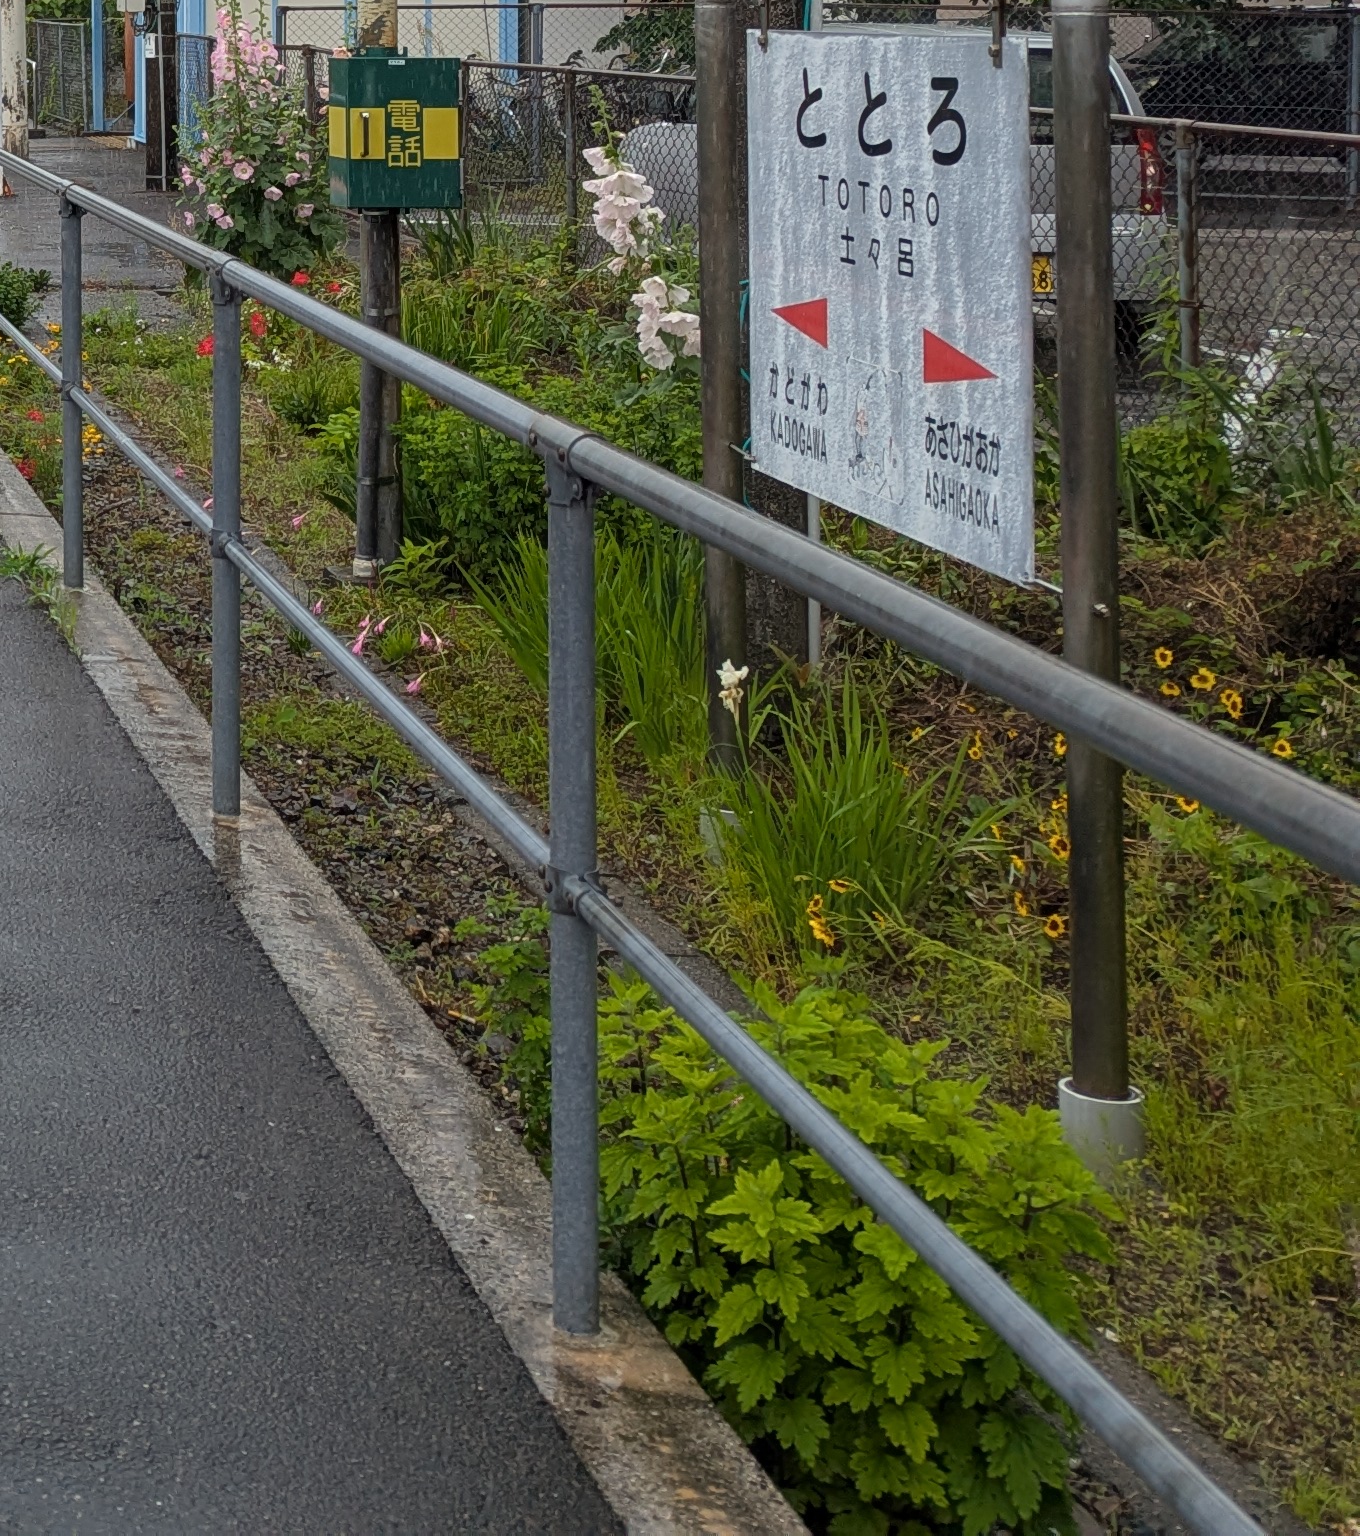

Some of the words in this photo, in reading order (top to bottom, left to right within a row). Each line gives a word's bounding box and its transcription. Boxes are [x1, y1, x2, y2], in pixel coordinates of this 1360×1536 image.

[387, 99, 421, 167] 電話
[796, 67, 967, 166] ととろ
[817, 174, 940, 228] TOTORO
[840, 227, 914, 278] 土々呂
[769, 361, 829, 416] かどがわ
[770, 409, 828, 464] KADOGAWA
[925, 412, 1001, 478] あさひがおか
[925, 468, 1001, 536] ASAHIGAOKA
